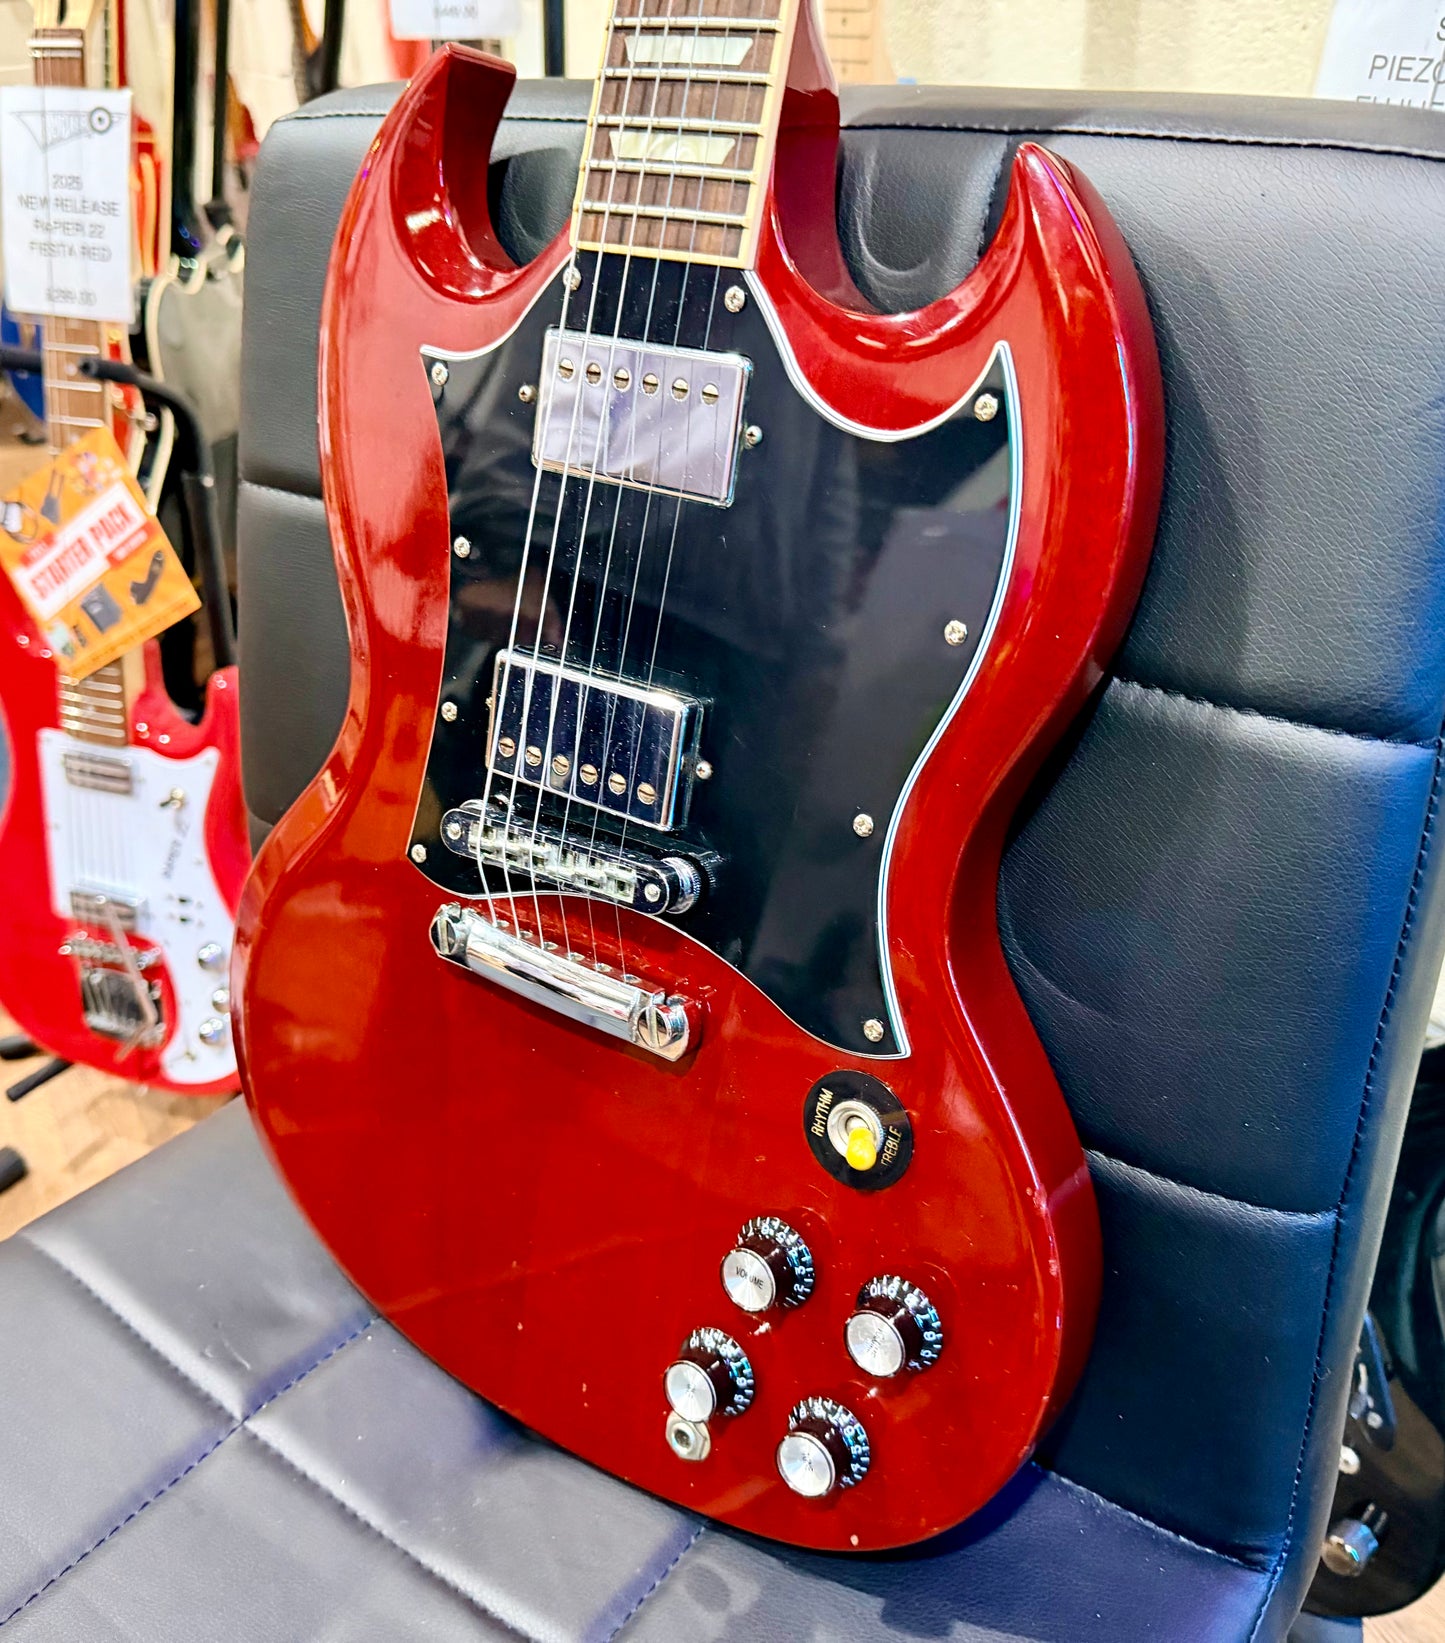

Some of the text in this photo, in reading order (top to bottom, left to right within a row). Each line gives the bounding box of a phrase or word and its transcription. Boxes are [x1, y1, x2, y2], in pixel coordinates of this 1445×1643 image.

[52, 174, 83, 190] 2025
[17, 195, 120, 217] NEW RELEASE
[89, 223, 106, 238] 22
[80, 244, 112, 262] RED
[30, 536, 93, 600] STARTER
[89, 501, 133, 546] PACK
[810, 1087, 834, 1137] RHYTHM
[880, 1125, 902, 1166] TREBLE
